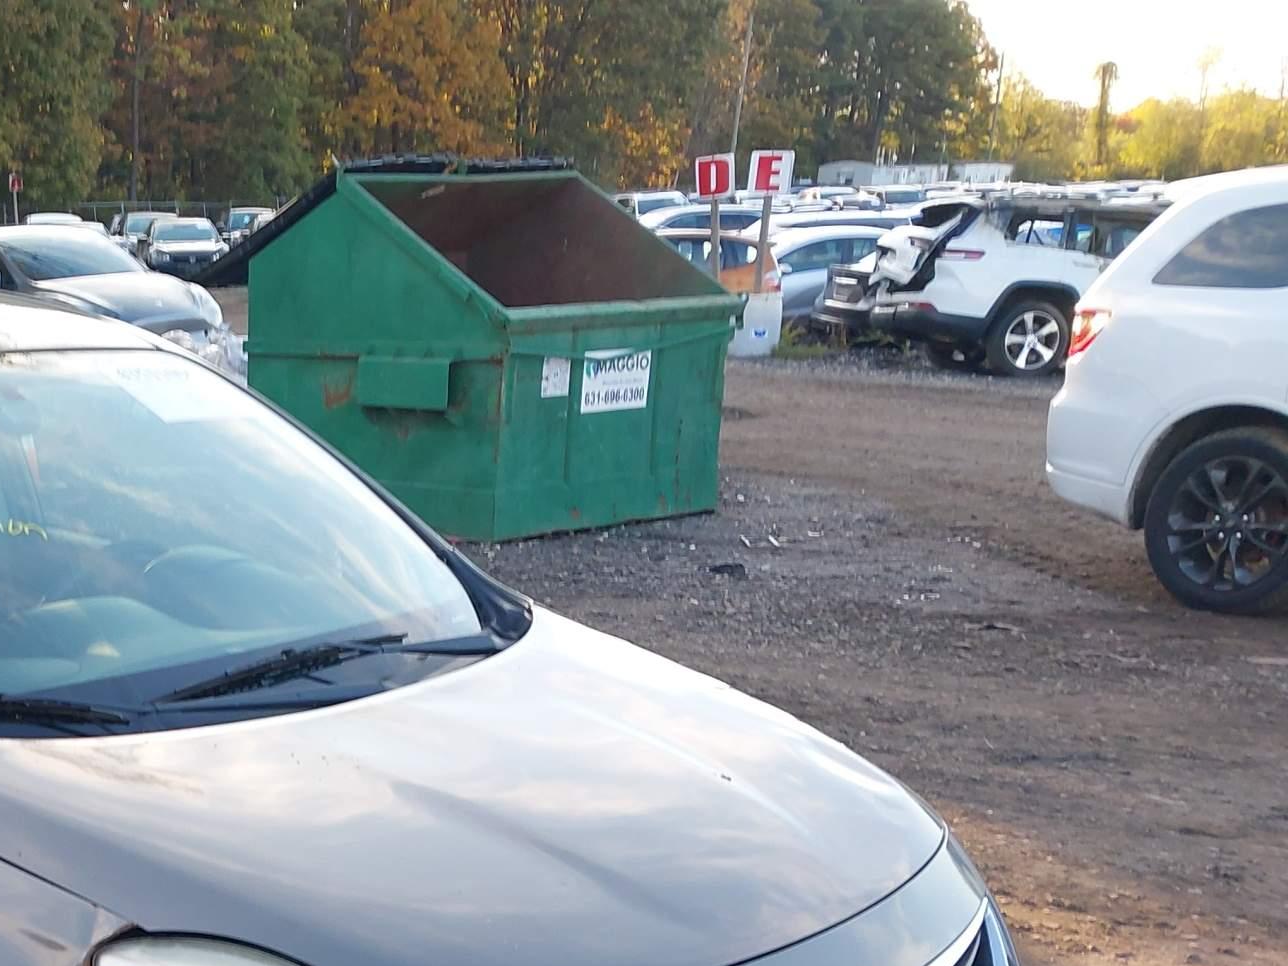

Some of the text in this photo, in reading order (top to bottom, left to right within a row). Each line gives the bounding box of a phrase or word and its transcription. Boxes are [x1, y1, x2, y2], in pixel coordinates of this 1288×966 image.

[698, 159, 730, 196] D
[755, 156, 783, 190] E
[598, 353, 649, 375] MAGGIO
